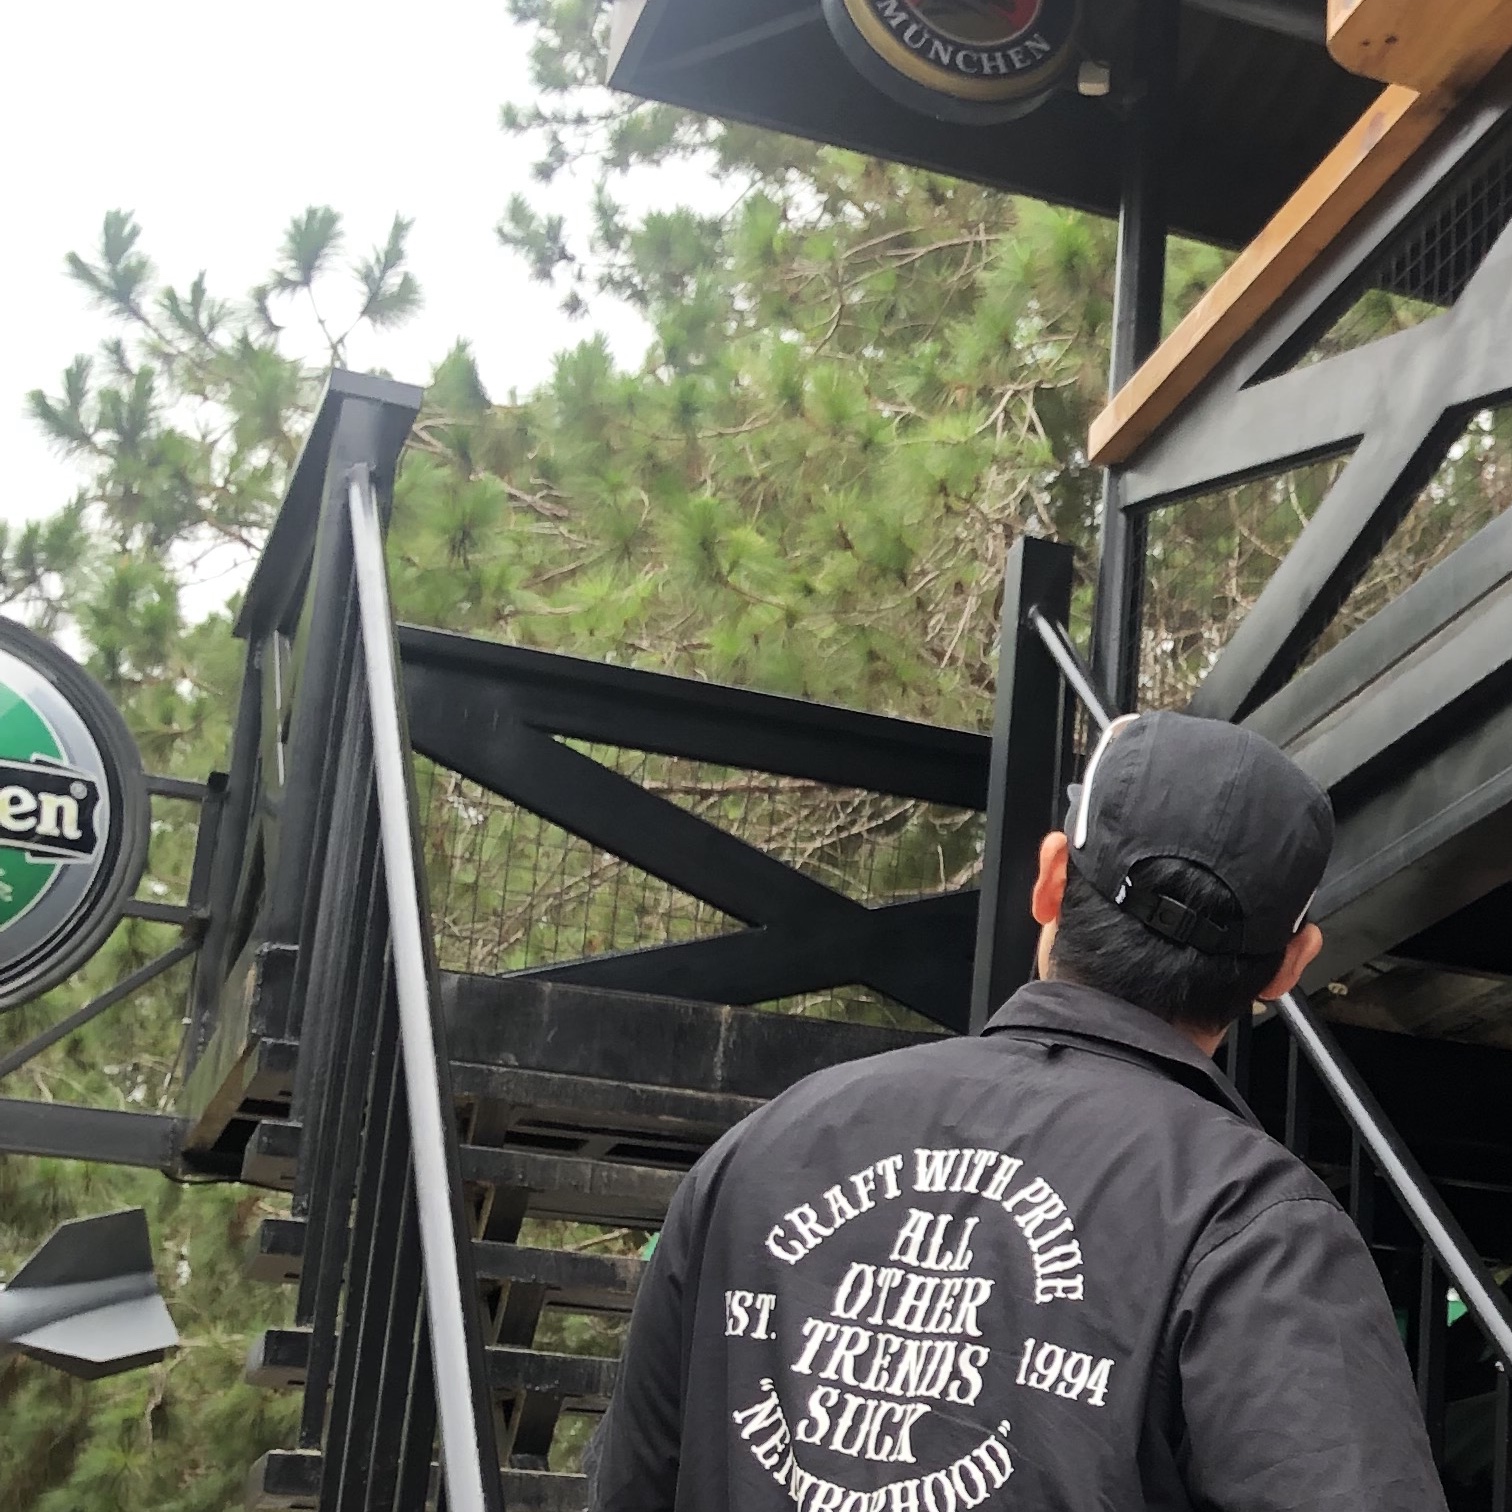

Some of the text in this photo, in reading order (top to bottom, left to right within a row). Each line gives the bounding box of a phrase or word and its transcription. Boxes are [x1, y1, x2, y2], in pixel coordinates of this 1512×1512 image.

[765, 1147, 1085, 1305] CRAFT WITH PRIDE
[889, 1207, 981, 1271] ALL
[829, 1261, 995, 1337] OTHER
[790, 1316, 991, 1406] TRENDS
[1015, 1336, 1115, 1407] 1994
[794, 1384, 931, 1464] SUCK
